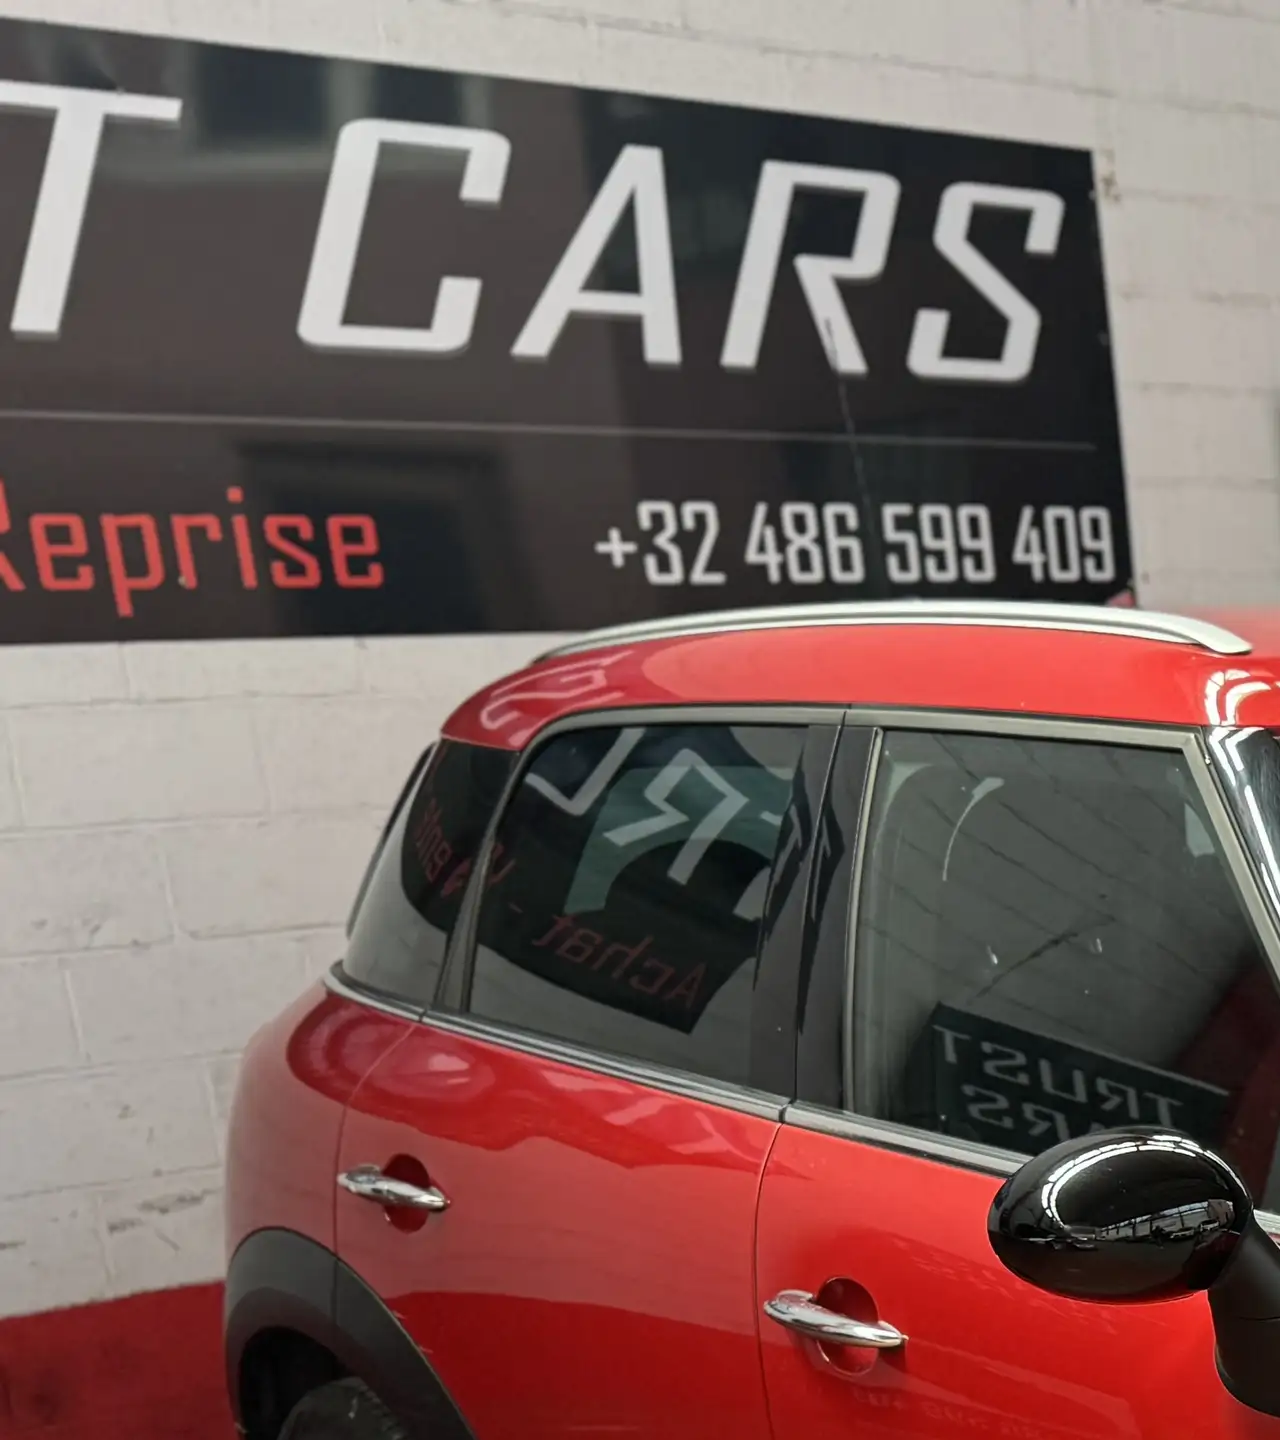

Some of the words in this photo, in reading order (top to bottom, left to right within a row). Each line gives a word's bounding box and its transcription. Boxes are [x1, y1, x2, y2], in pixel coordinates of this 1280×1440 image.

[297, 118, 1065, 382] CARS
[595, 500, 727, 585] +32
[744, 501, 865, 585] 486
[881, 504, 997, 583] 599
[1012, 505, 1117, 583] 409
